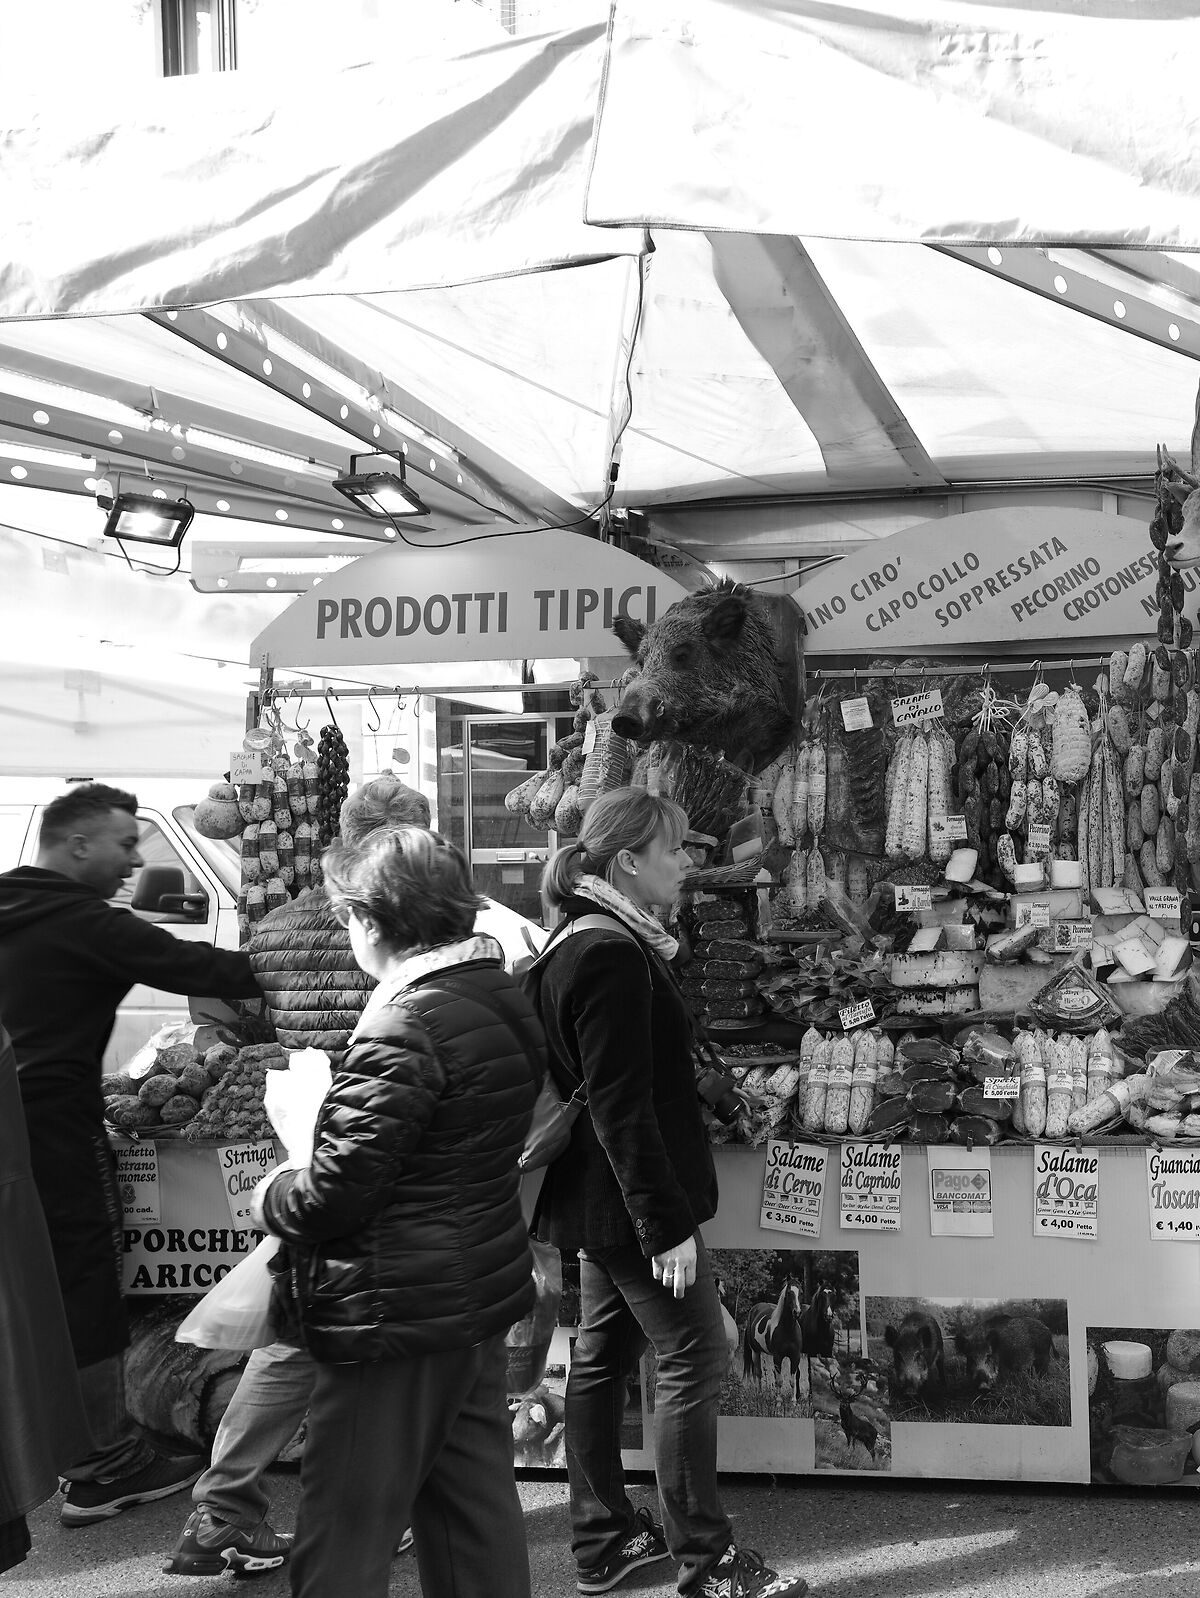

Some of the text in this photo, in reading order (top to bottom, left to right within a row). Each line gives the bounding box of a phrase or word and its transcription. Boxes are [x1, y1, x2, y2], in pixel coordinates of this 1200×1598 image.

[865, 551, 981, 633] CAPOCOLLO
[934, 536, 1069, 628] SOPPRESSATA
[1010, 556, 1102, 623] PECORINO
[1062, 549, 1159, 622] CROTONESE
[316, 586, 657, 640] PRODOTTI TIPICI
[801, 591, 846, 636] INO
[892, 691, 931, 708] SALAME
[896, 704, 942, 722] CAVALLO
[839, 1001, 870, 1017] Filetto
[223, 1145, 275, 1169] Stringa
[767, 1145, 825, 1173] Salame
[841, 1144, 901, 1169] Salame
[1036, 1149, 1099, 1174] Salame
[765, 1166, 822, 1197] di Cervo
[841, 1167, 901, 1195] di Capriolo
[934, 1171, 971, 1191] Pago
[1036, 1173, 1098, 1201] d'Oca
[936, 1192, 987, 1200] BANCOMAT
[135, 1206, 154, 1214] cad.
[236, 1209, 244, 1218] €
[766, 1212, 773, 1220] €
[775, 1212, 797, 1224] 3,50
[845, 1213, 853, 1222] €
[855, 1213, 878, 1225] 4,00
[1067, 1208, 1082, 1216] Oie
[1041, 1218, 1048, 1227] €
[1050, 1218, 1074, 1229] 4,00
[1156, 1221, 1164, 1230] €
[1167, 1221, 1193, 1232] 1,40
